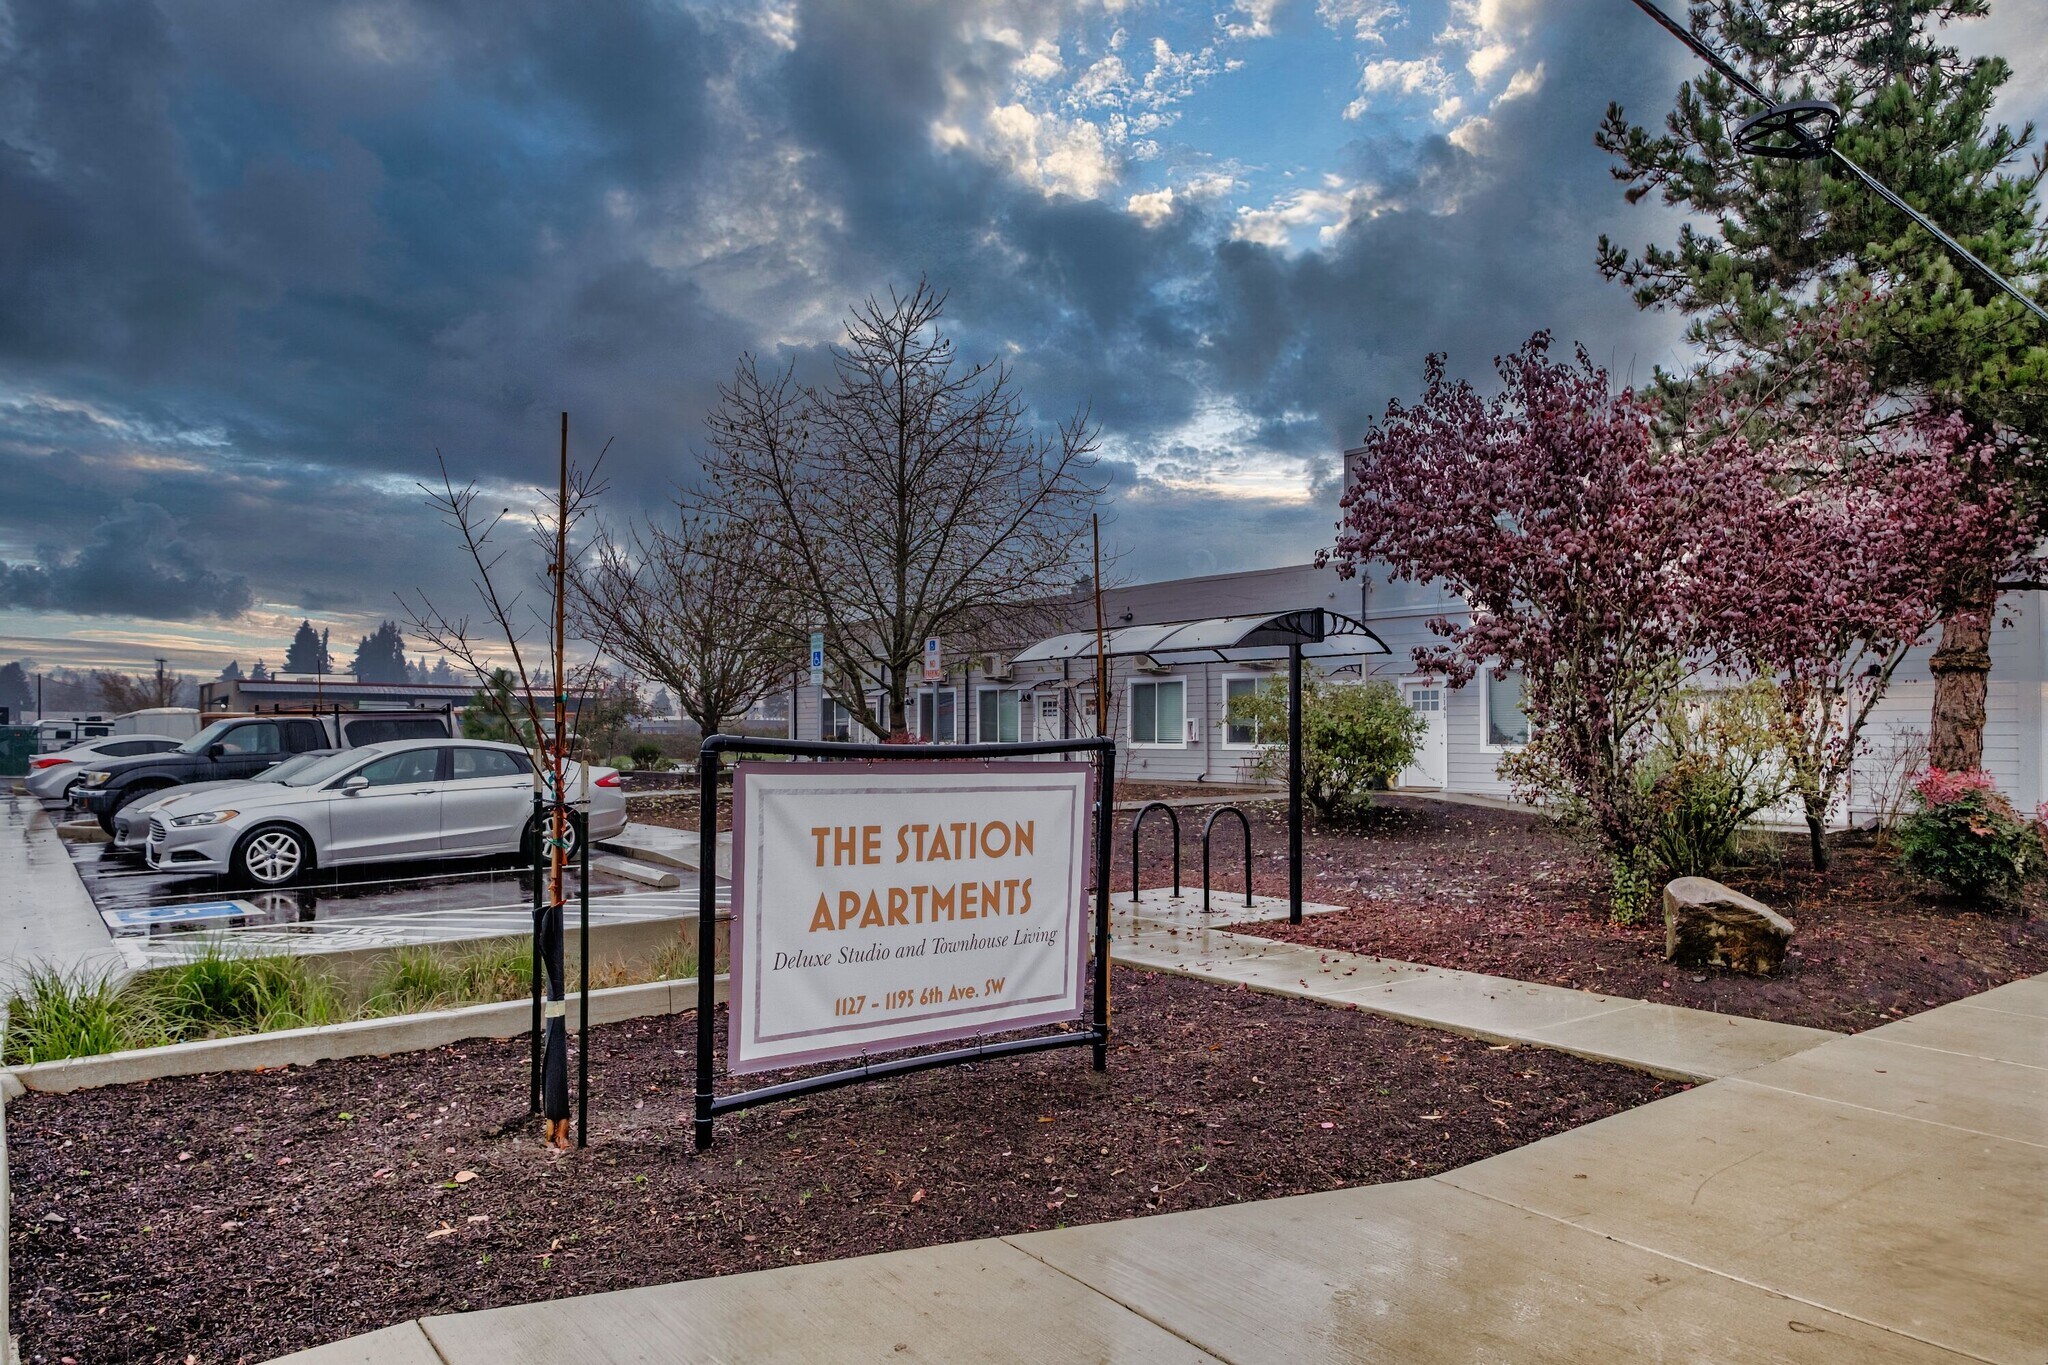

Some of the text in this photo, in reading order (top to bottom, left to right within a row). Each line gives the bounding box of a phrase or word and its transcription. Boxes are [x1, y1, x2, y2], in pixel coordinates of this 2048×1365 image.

[811, 820, 1035, 867] THE STATION
[808, 878, 1033, 932] APARTMENTS
[772, 927, 1058, 971] Deluxe Studio and Townhouse Living
[835, 995, 866, 1016] 1127
[885, 989, 914, 1010] 1195
[919, 986, 943, 1006] 6th
[947, 983, 979, 1002] Ave.
[984, 976, 1006, 996] SW
